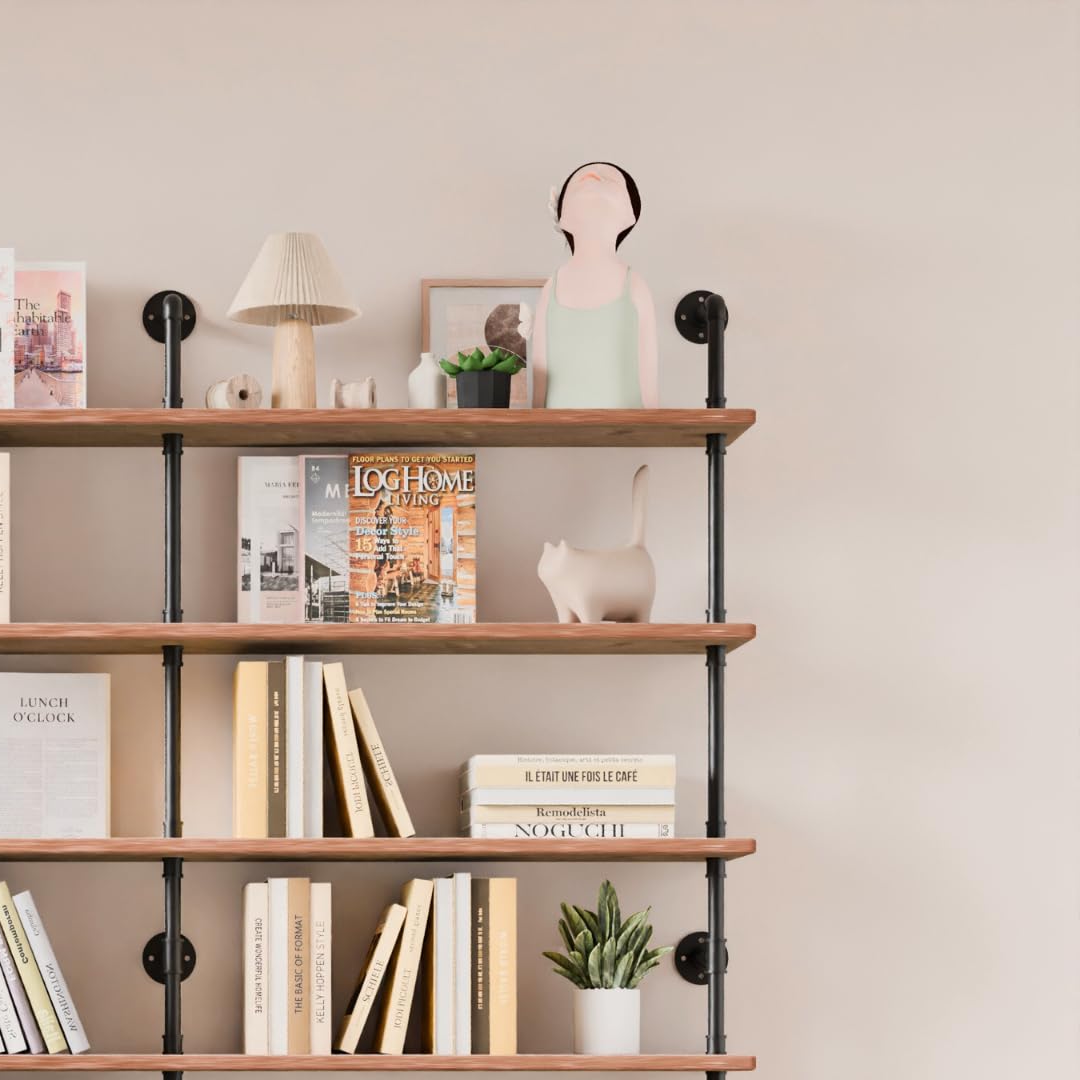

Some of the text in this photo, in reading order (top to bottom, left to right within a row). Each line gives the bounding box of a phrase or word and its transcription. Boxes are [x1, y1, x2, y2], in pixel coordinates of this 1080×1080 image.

[15, 298, 40, 310] The
[389, 494, 439, 505] LIVING
[389, 516, 408, 524] YOUR
[356, 537, 372, 551] 15
[20, 697, 69, 708] LUNCH
[13, 712, 76, 723] O'CLOCK
[525, 768, 638, 782] IL ÉTAIT UNE FOIS LE CAFÉ
[536, 807, 606, 817] Remodelista
[515, 824, 624, 837] NOGUCHI
[294, 915, 303, 1014] THE BASIC OF FORMAT
[316, 921, 325, 1023] KELLY HOPPEN STYLE
